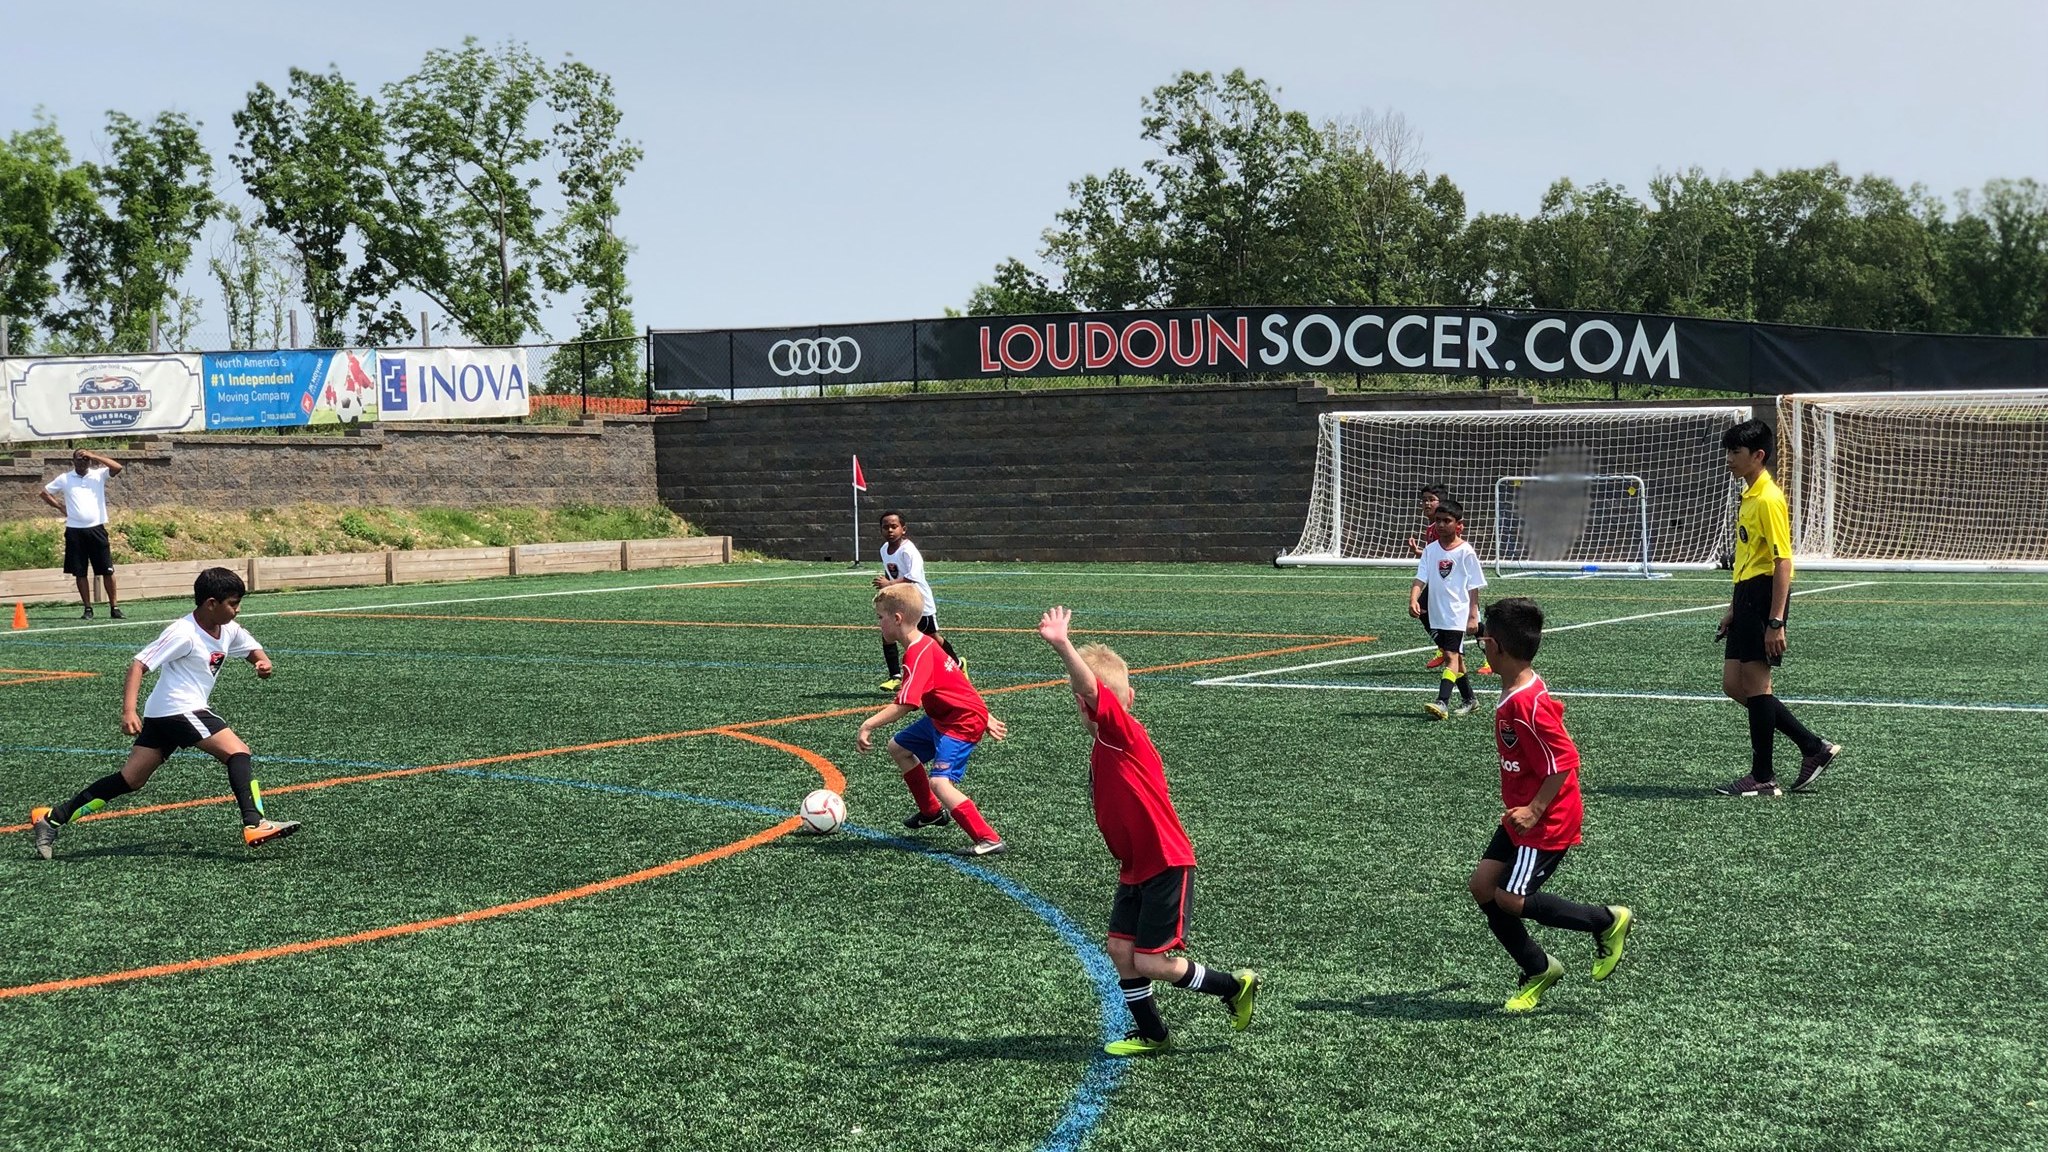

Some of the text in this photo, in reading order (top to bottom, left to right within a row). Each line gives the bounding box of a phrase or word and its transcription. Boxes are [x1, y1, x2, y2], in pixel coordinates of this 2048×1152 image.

[215, 356, 287, 369] North America's
[211, 371, 294, 388] #1 Independent
[418, 363, 526, 403] INOVA
[75, 394, 147, 411] FORD'S
[218, 391, 249, 404] Moving
[251, 390, 290, 403] Company
